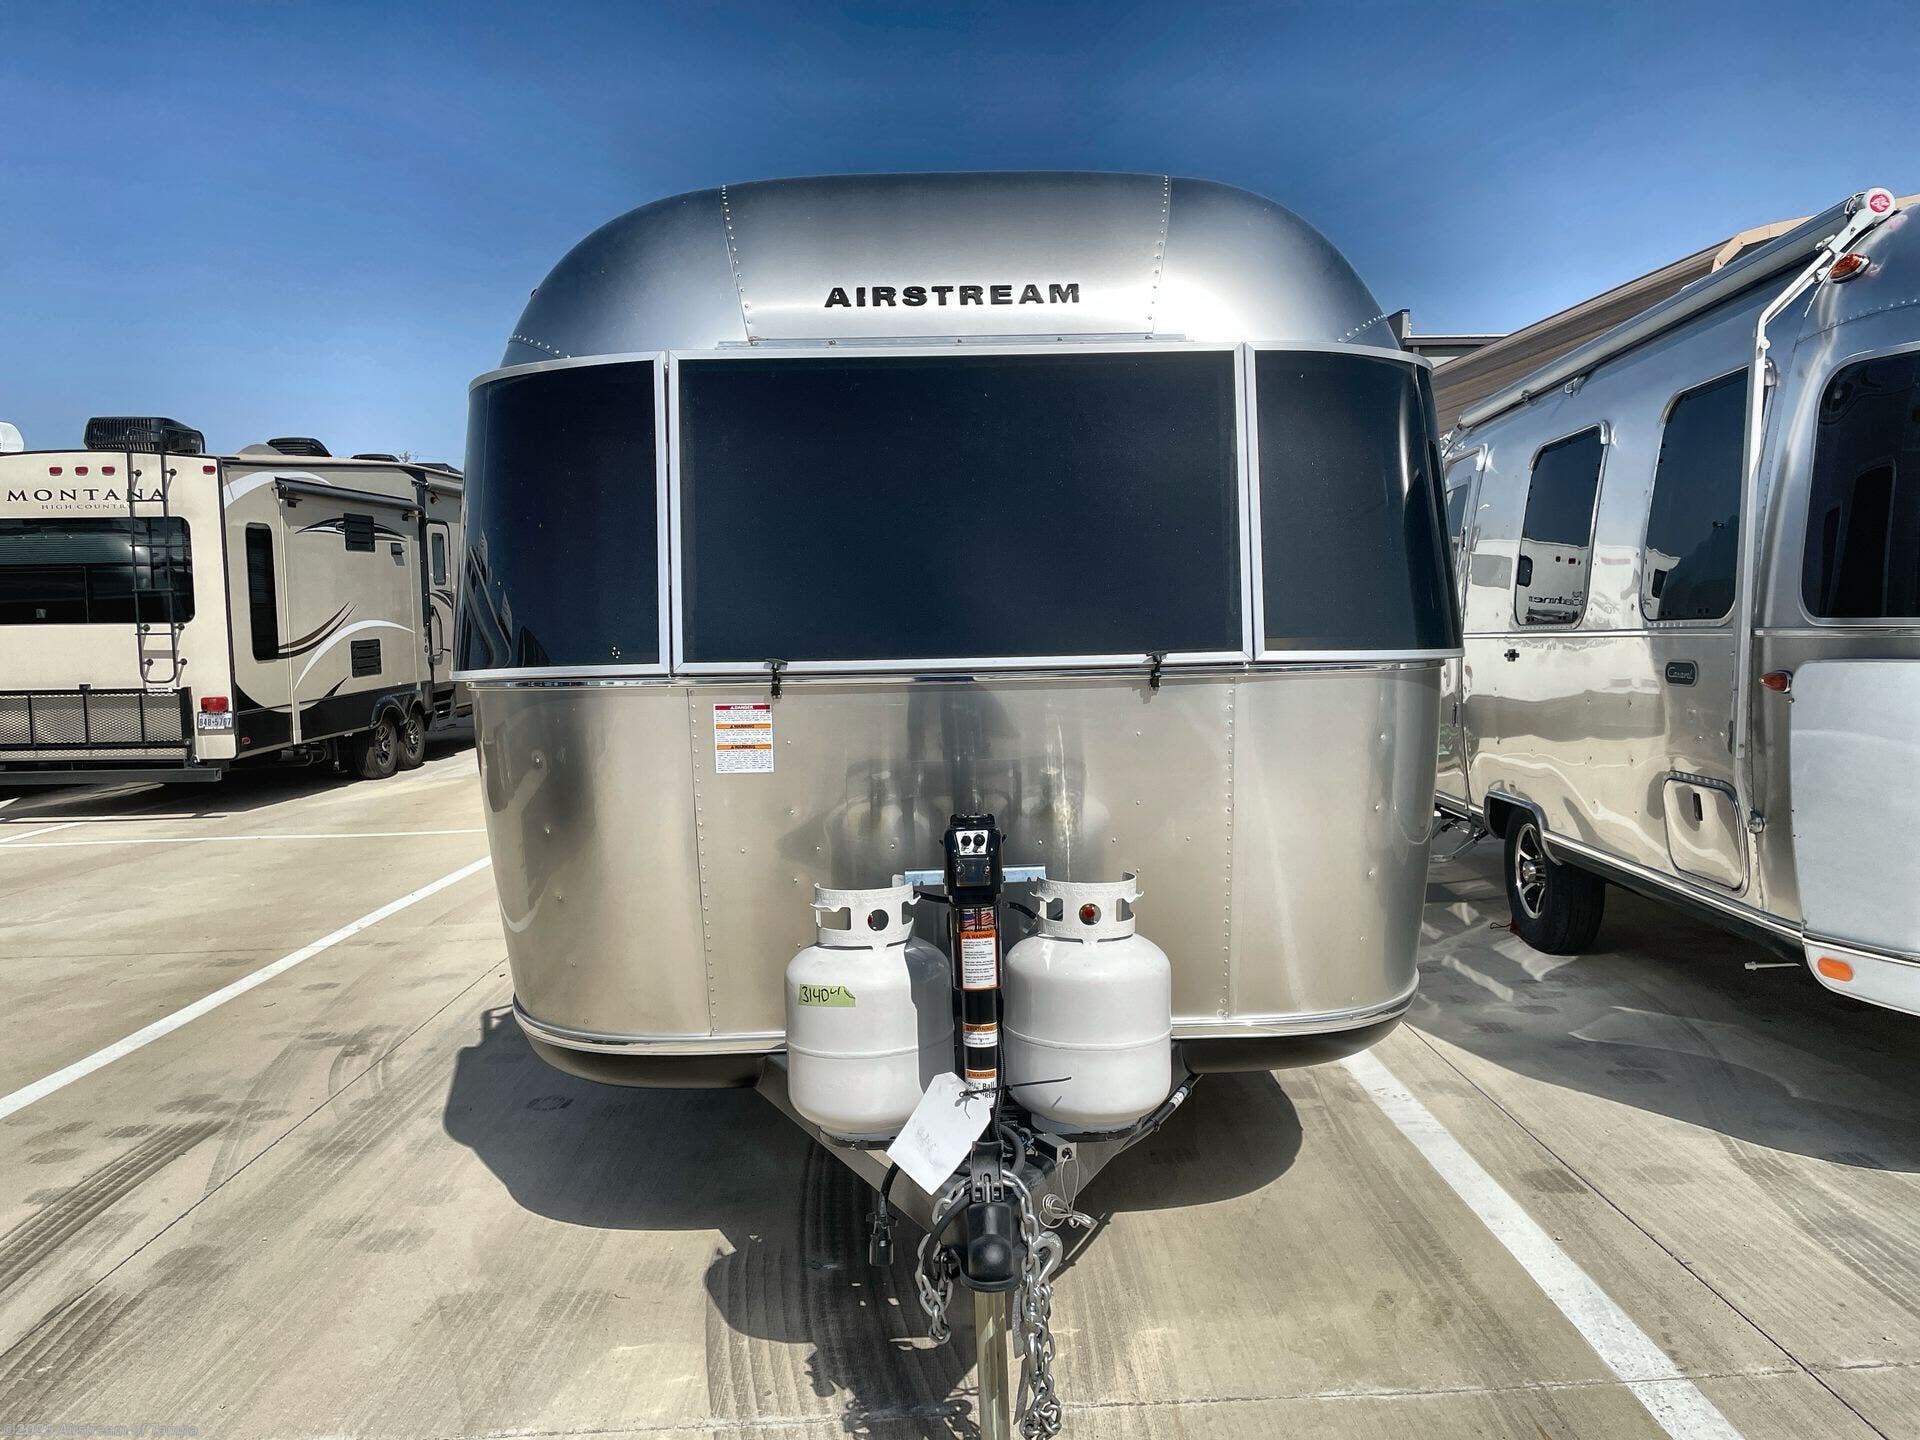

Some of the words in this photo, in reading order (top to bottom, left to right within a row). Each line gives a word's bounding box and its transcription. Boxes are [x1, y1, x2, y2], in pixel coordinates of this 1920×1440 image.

[824, 284, 1080, 308] AIRSTREAM
[6, 488, 167, 502] MONTANA
[76, 502, 132, 510] COUNTR
